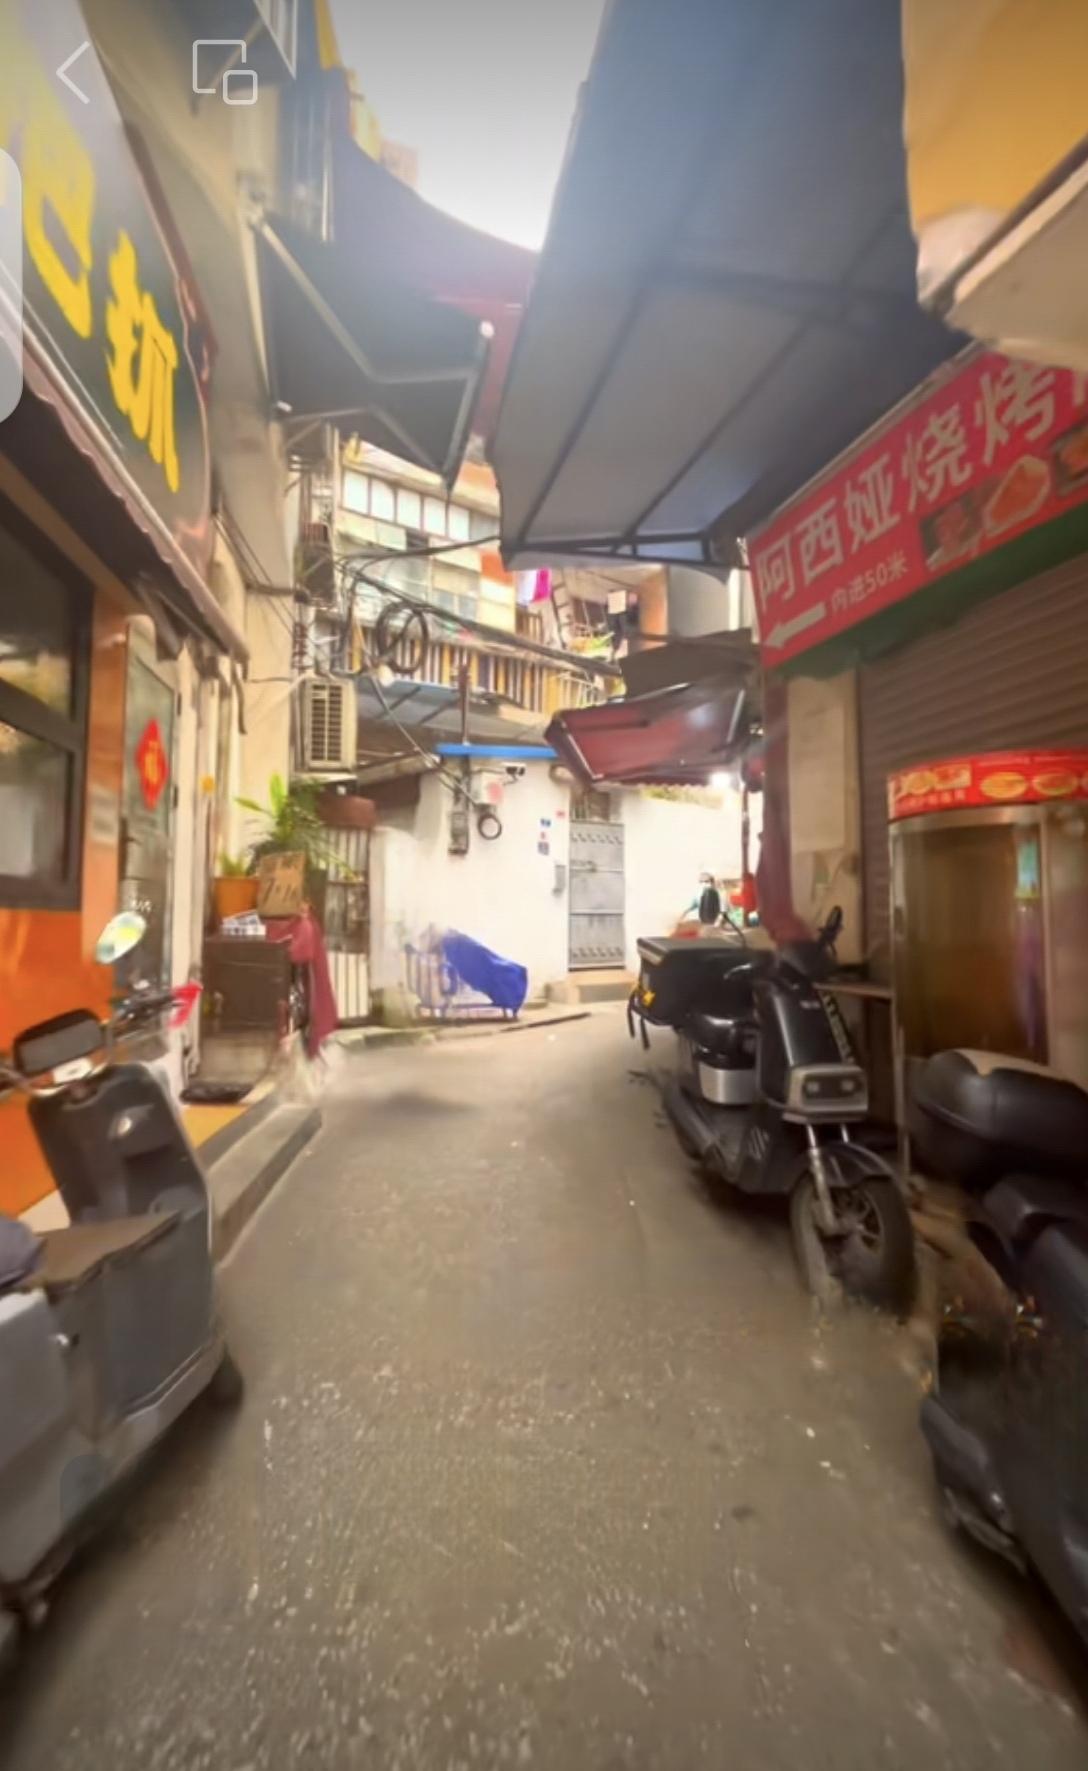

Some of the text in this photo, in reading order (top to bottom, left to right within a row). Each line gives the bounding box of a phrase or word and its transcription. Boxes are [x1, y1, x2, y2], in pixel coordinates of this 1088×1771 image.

[754, 360, 1087, 612] 阿西娅烧烤
